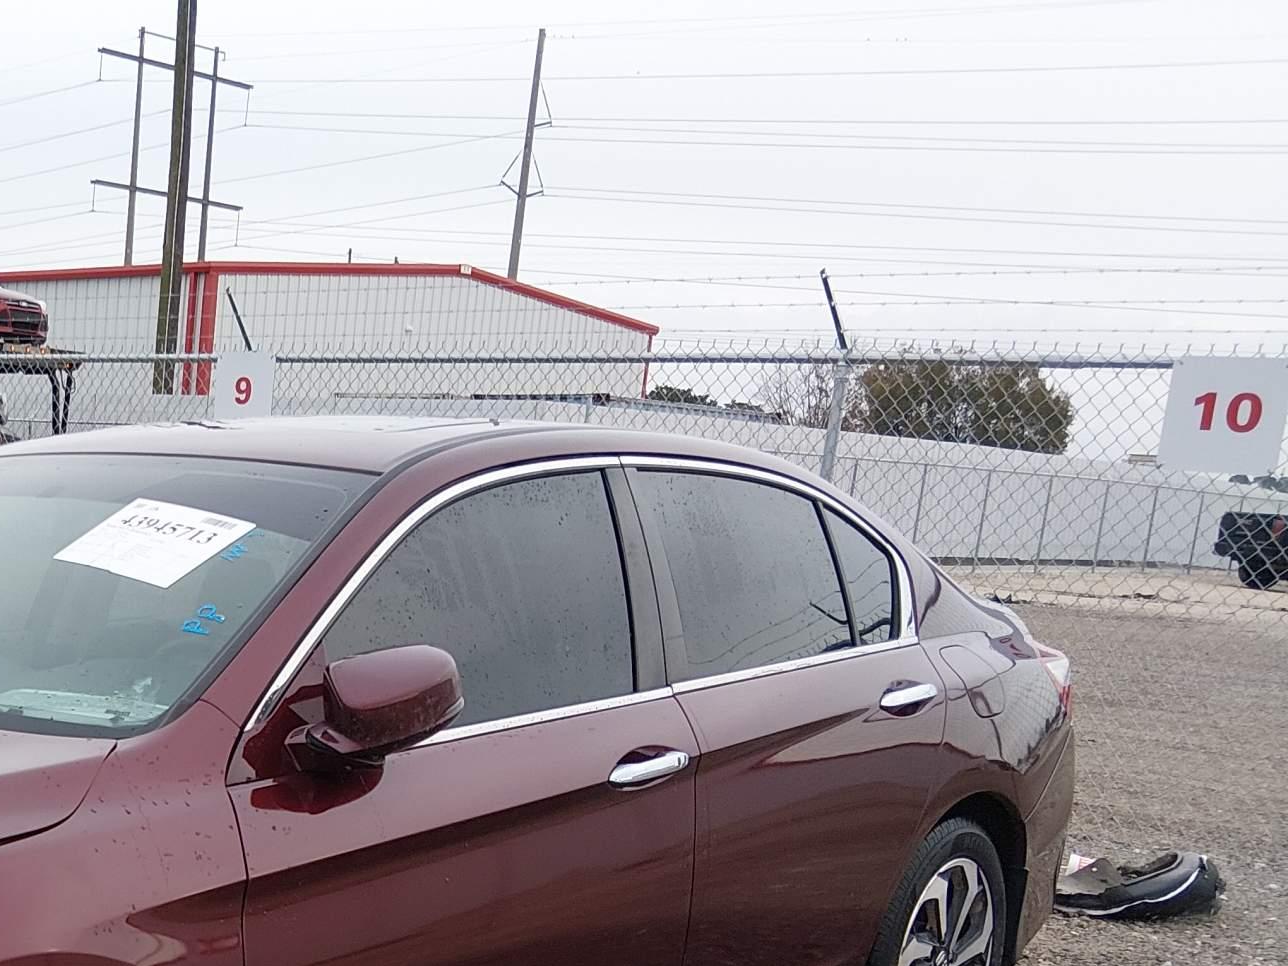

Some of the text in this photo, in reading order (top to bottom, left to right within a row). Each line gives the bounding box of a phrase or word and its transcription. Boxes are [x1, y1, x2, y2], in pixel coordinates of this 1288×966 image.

[234, 376, 252, 405] 9
[1193, 391, 1263, 433] 10
[120, 513, 219, 546] 43945713
